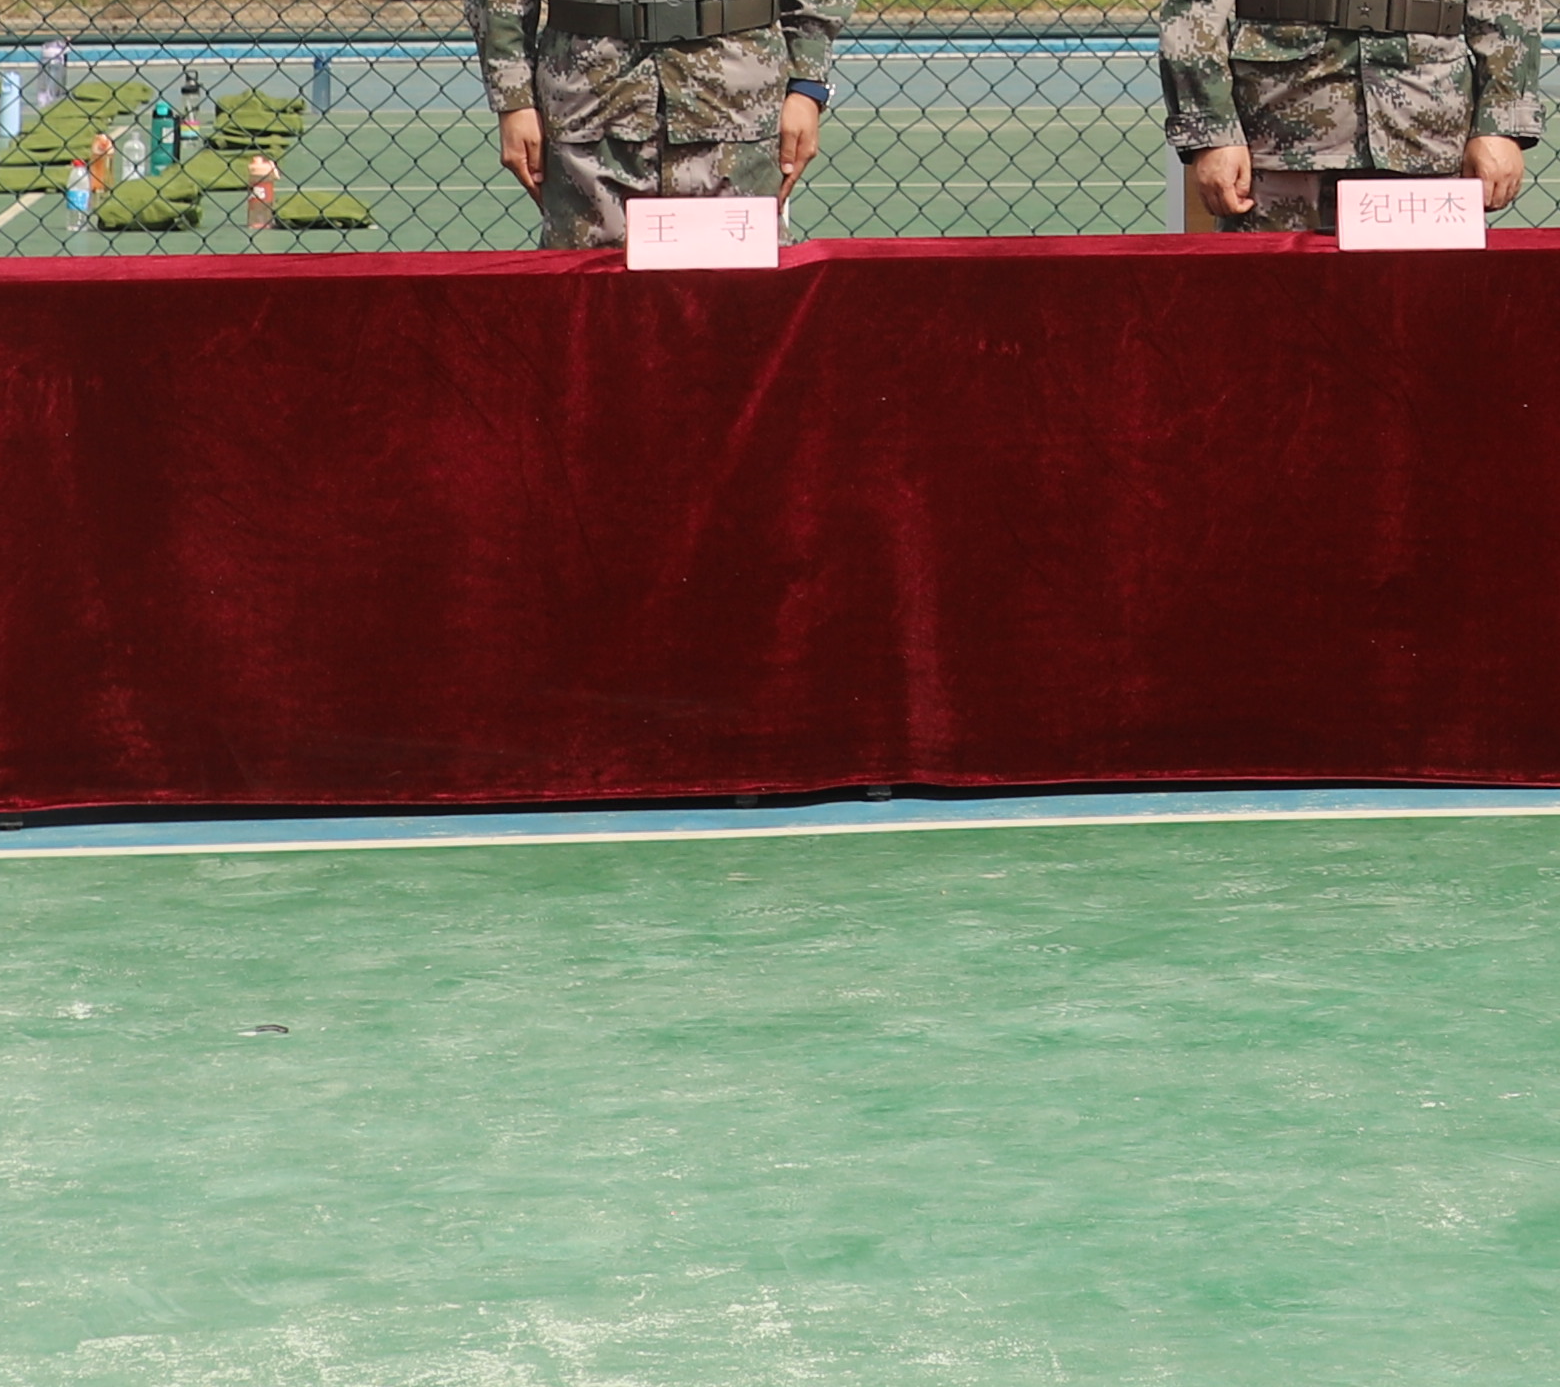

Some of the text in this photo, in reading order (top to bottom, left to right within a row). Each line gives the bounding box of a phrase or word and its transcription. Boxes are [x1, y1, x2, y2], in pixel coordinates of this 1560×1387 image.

[1359, 191, 1467, 224] 纪中杰
[643, 209, 755, 244] 王寻
